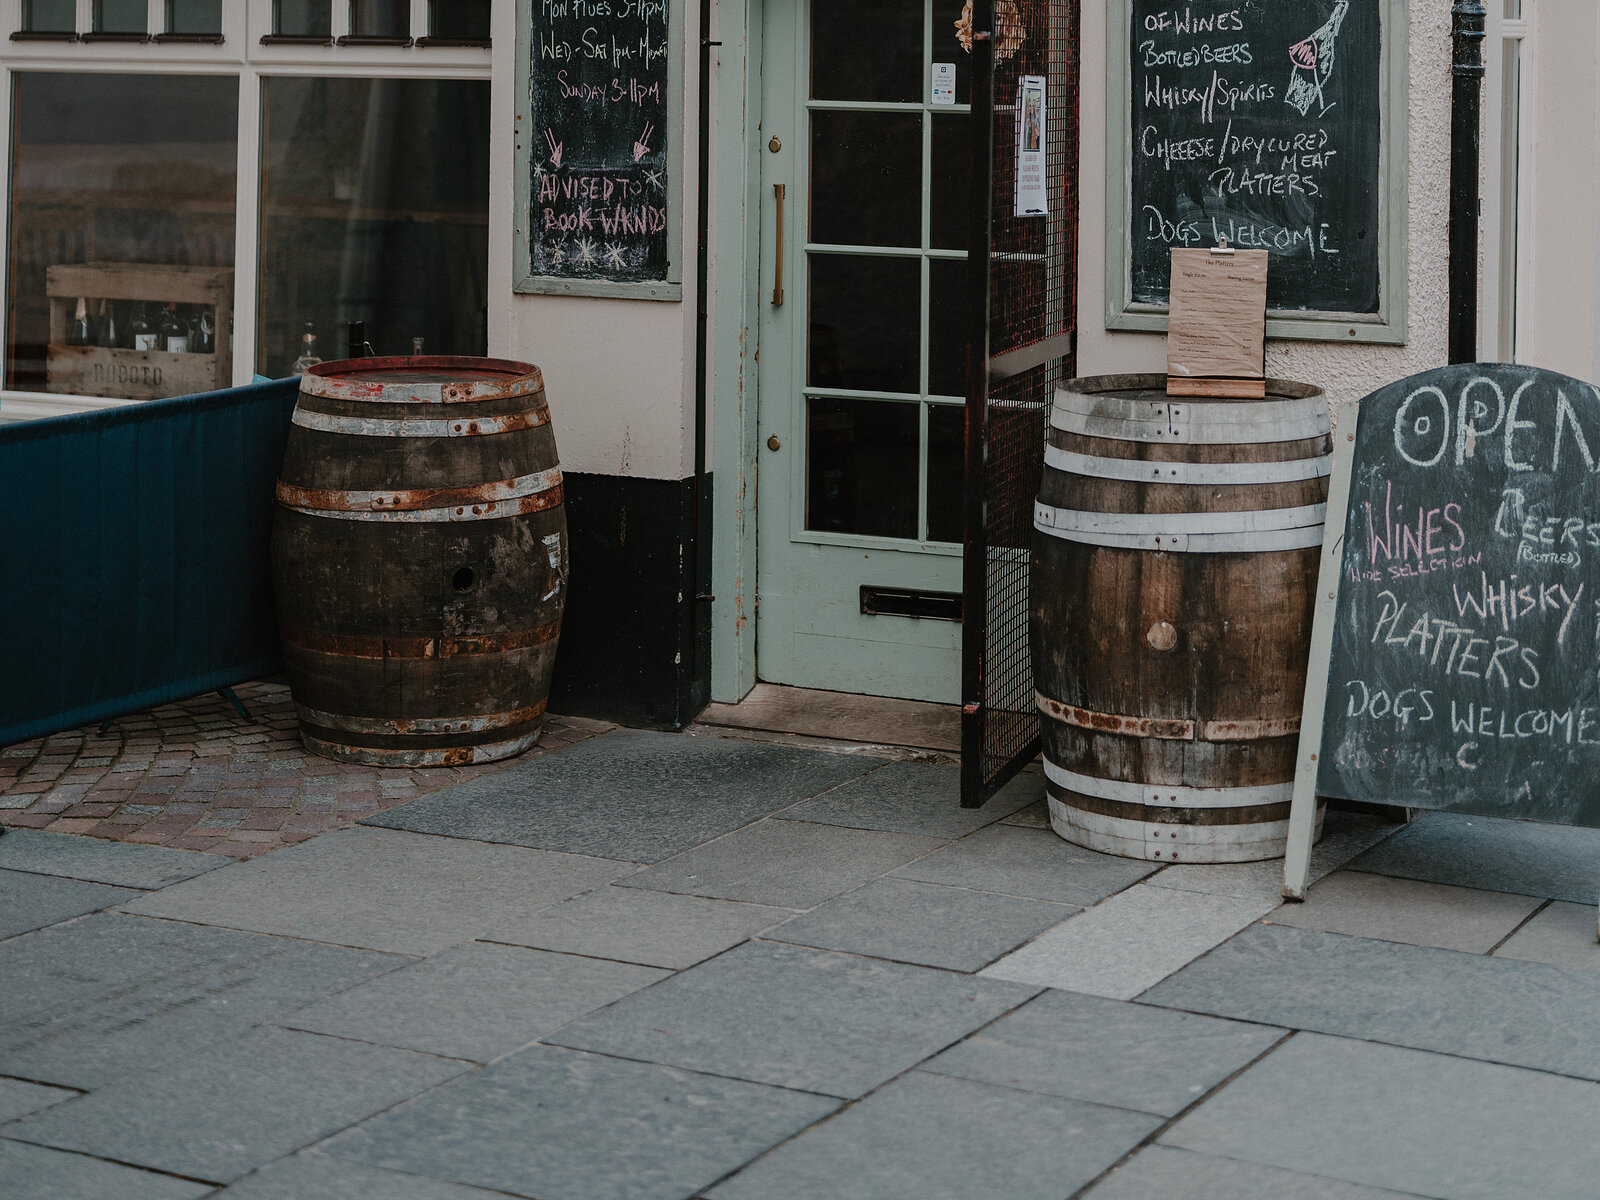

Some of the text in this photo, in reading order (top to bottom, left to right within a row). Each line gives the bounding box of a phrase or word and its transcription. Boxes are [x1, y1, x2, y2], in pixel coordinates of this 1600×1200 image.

[1145, 7, 1243, 35] OF WINES
[1139, 40, 1253, 68] BOTTLED BEERS
[557, 70, 607, 107] SUNDAY
[1281, 151, 1337, 172] MEAT
[539, 174, 642, 204] ADVISED TO
[543, 202, 666, 235] BOOK WKNDS
[1143, 204, 1340, 260] DOGS WELCOME
[1394, 376, 1600, 473] OPEN
[1365, 480, 1465, 564] WINES
[1452, 571, 1585, 644] WHISKY
[1371, 590, 1540, 689] PLATTERS
[1346, 680, 1600, 744] DOGS WELCOME
